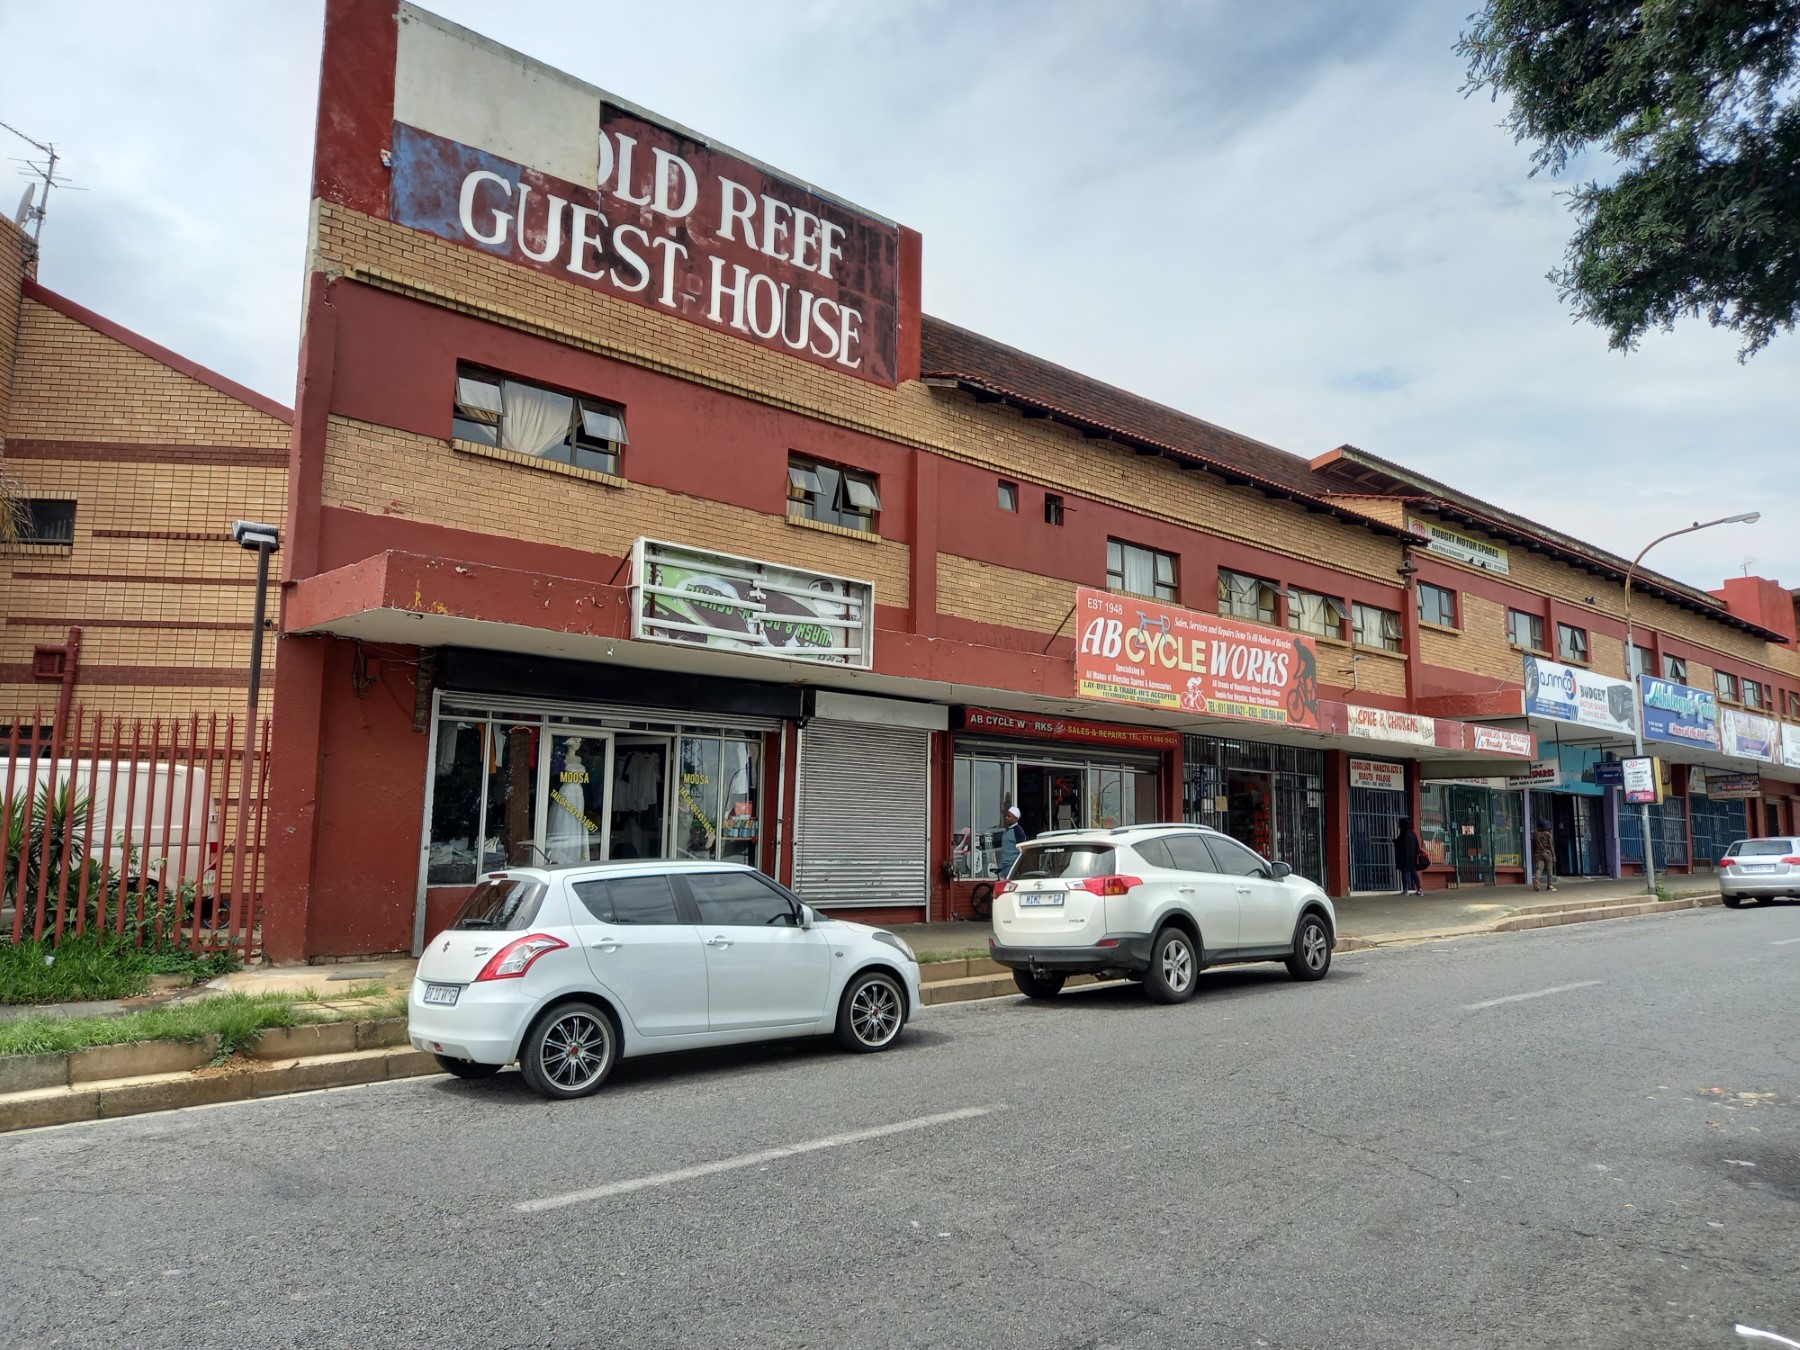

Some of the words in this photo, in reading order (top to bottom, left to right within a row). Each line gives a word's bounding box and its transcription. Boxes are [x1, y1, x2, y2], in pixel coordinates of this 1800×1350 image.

[716, 175, 847, 279] REEF
[459, 170, 689, 308] GUEST
[706, 255, 863, 368] HOUSE
[1432, 528, 1456, 543] BUDGET
[1456, 536, 1477, 551] MOTOR
[1478, 542, 1498, 558] SPARES
[1087, 598, 1103, 610] EST
[1105, 601, 1123, 615] 1948
[1208, 624, 1218, 634] and
[1218, 626, 1235, 638] Repairs
[1235, 630, 1246, 640] Done
[1081, 617, 1124, 658] AB
[1125, 628, 1207, 674] CYCLE
[1210, 640, 1290, 688] WORKS
[1084, 681, 1112, 692] LAY-BYE'S
[1119, 686, 1149, 696] TRADE-IN'S
[1150, 692, 1176, 701] ACCEPTED
[1580, 685, 1606, 702] BUDGET
[970, 714, 983, 724] AB
[986, 716, 1014, 727] CYCLE
[1067, 726, 1090, 735] SALES
[1099, 730, 1127, 739] REPAIRS
[560, 771, 590, 784] MOOSA
[684, 773, 709, 784] MOOSA
[1532, 769, 1554, 778] SPARES
[550, 789, 568, 806] TAILOR
